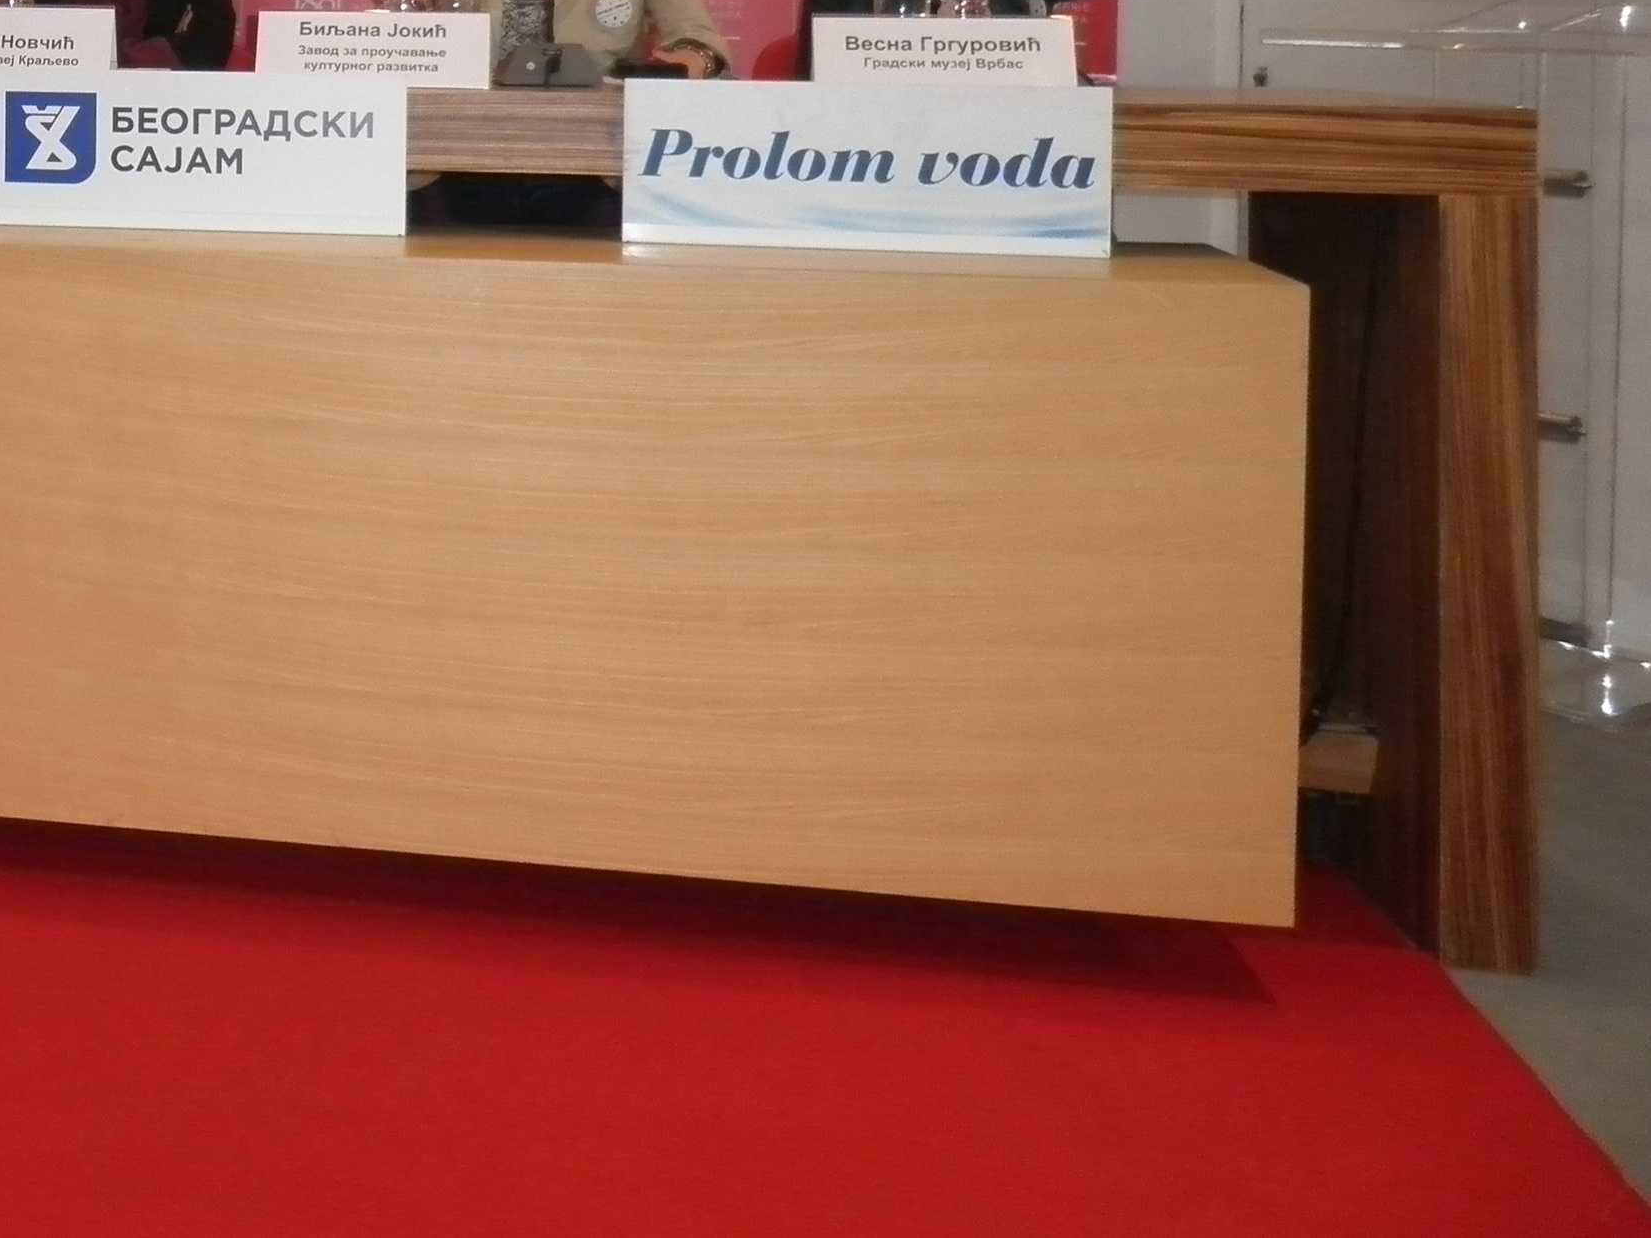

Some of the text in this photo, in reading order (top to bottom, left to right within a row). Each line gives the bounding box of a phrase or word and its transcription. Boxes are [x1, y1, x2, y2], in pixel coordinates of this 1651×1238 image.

[299, 20, 448, 39] Биљана Јокић
[1, 34, 75, 51] Новчић
[845, 36, 1041, 55] Весна Гргуровић
[18, 55, 79, 68] Краљево
[298, 45, 447, 60] Завод за проучавање
[304, 60, 439, 74] културног развитка
[863, 58, 1024, 72] Градски музеј Врбас
[111, 106, 375, 142] БЕОГРАДСКИ
[110, 145, 244, 176] САЈАМ
[638, 128, 1096, 190] Prolom voda
